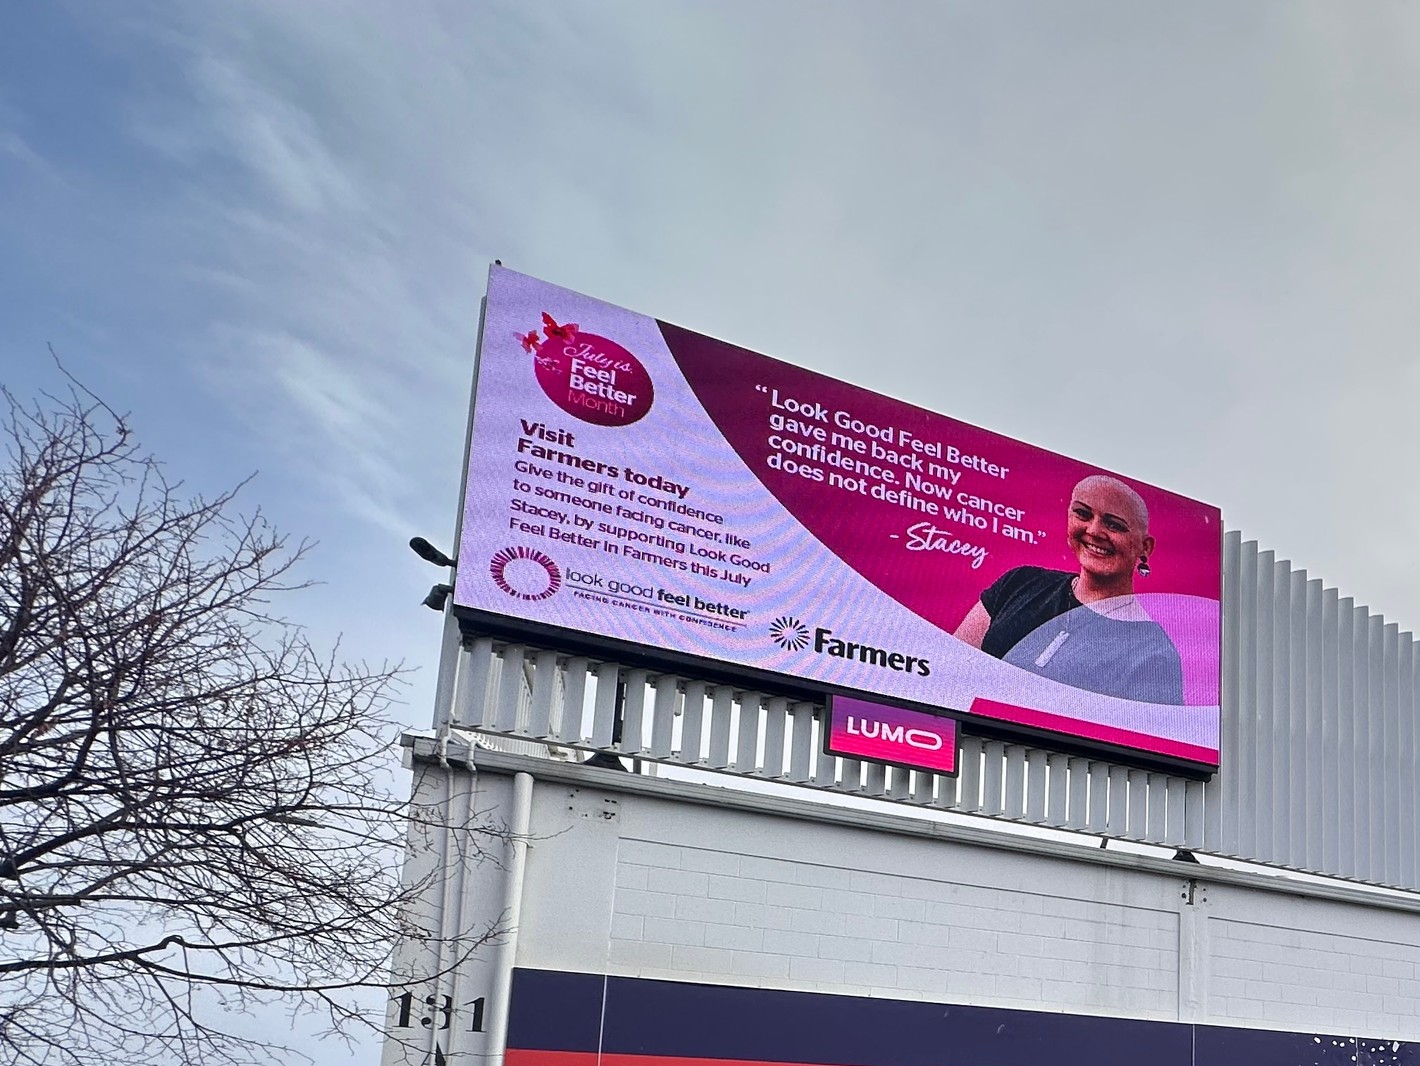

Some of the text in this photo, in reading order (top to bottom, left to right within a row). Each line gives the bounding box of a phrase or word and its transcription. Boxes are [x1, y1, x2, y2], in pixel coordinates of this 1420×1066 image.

[564, 343, 612, 368] July
[571, 358, 616, 385] Feel
[568, 389, 625, 418] Month
[569, 373, 637, 406] Better
[520, 418, 575, 448] Visit
[769, 414, 962, 485] gave me back my
[834, 411, 894, 444] Good
[899, 429, 942, 459] Feel
[947, 445, 1009, 479] Better
[514, 460, 724, 525] Give the gift of confidence
[517, 437, 690, 499] Farmers today
[766, 452, 824, 482] does
[828, 471, 868, 495] not
[870, 482, 939, 515] define
[943, 505, 988, 530] who
[992, 517, 998, 534] I
[768, 434, 1025, 522] confidence. Now cancer
[510, 498, 771, 573] Stacey, by supporting Look Good
[513, 478, 751, 549] to someone facing cancer, like
[509, 517, 545, 536] Feel
[549, 526, 601, 549] Better
[623, 545, 688, 571] Farmers
[690, 561, 718, 578] this
[720, 569, 751, 588] July
[905, 522, 989, 569] Stacey
[565, 567, 747, 620] look good feel better
[573, 591, 738, 633] FACING CANCER WITH CONFIDENCE
[814, 627, 931, 676] Farmers
[846, 716, 943, 751] LUMO
